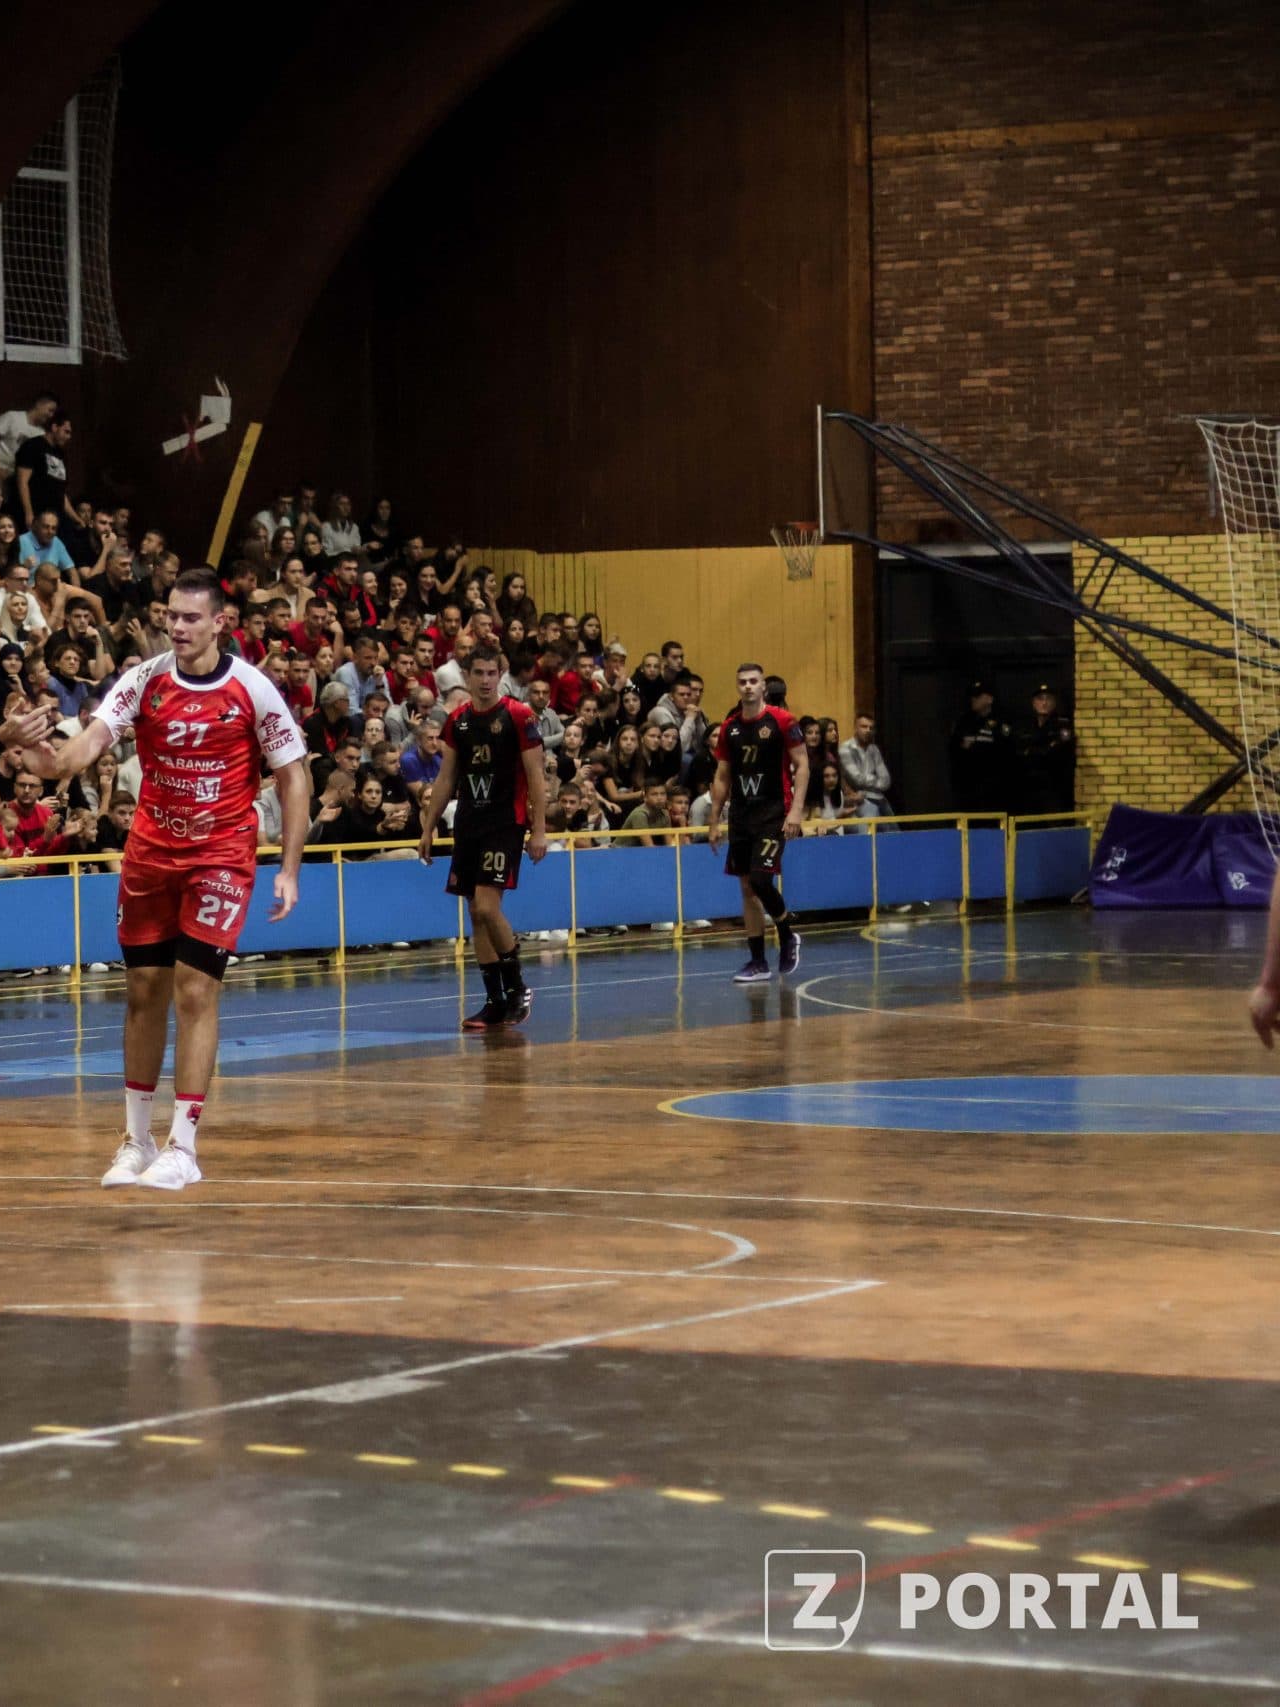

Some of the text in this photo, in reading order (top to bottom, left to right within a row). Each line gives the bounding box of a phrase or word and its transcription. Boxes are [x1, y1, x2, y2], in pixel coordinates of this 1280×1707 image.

[166, 720, 210, 747] 27
[472, 746, 491, 765] 20
[741, 744, 758, 763] 77
[467, 774, 495, 800] W
[738, 773, 764, 796] W
[760, 838, 780, 858] 77
[483, 852, 505, 871] 20
[196, 894, 241, 931] 27
